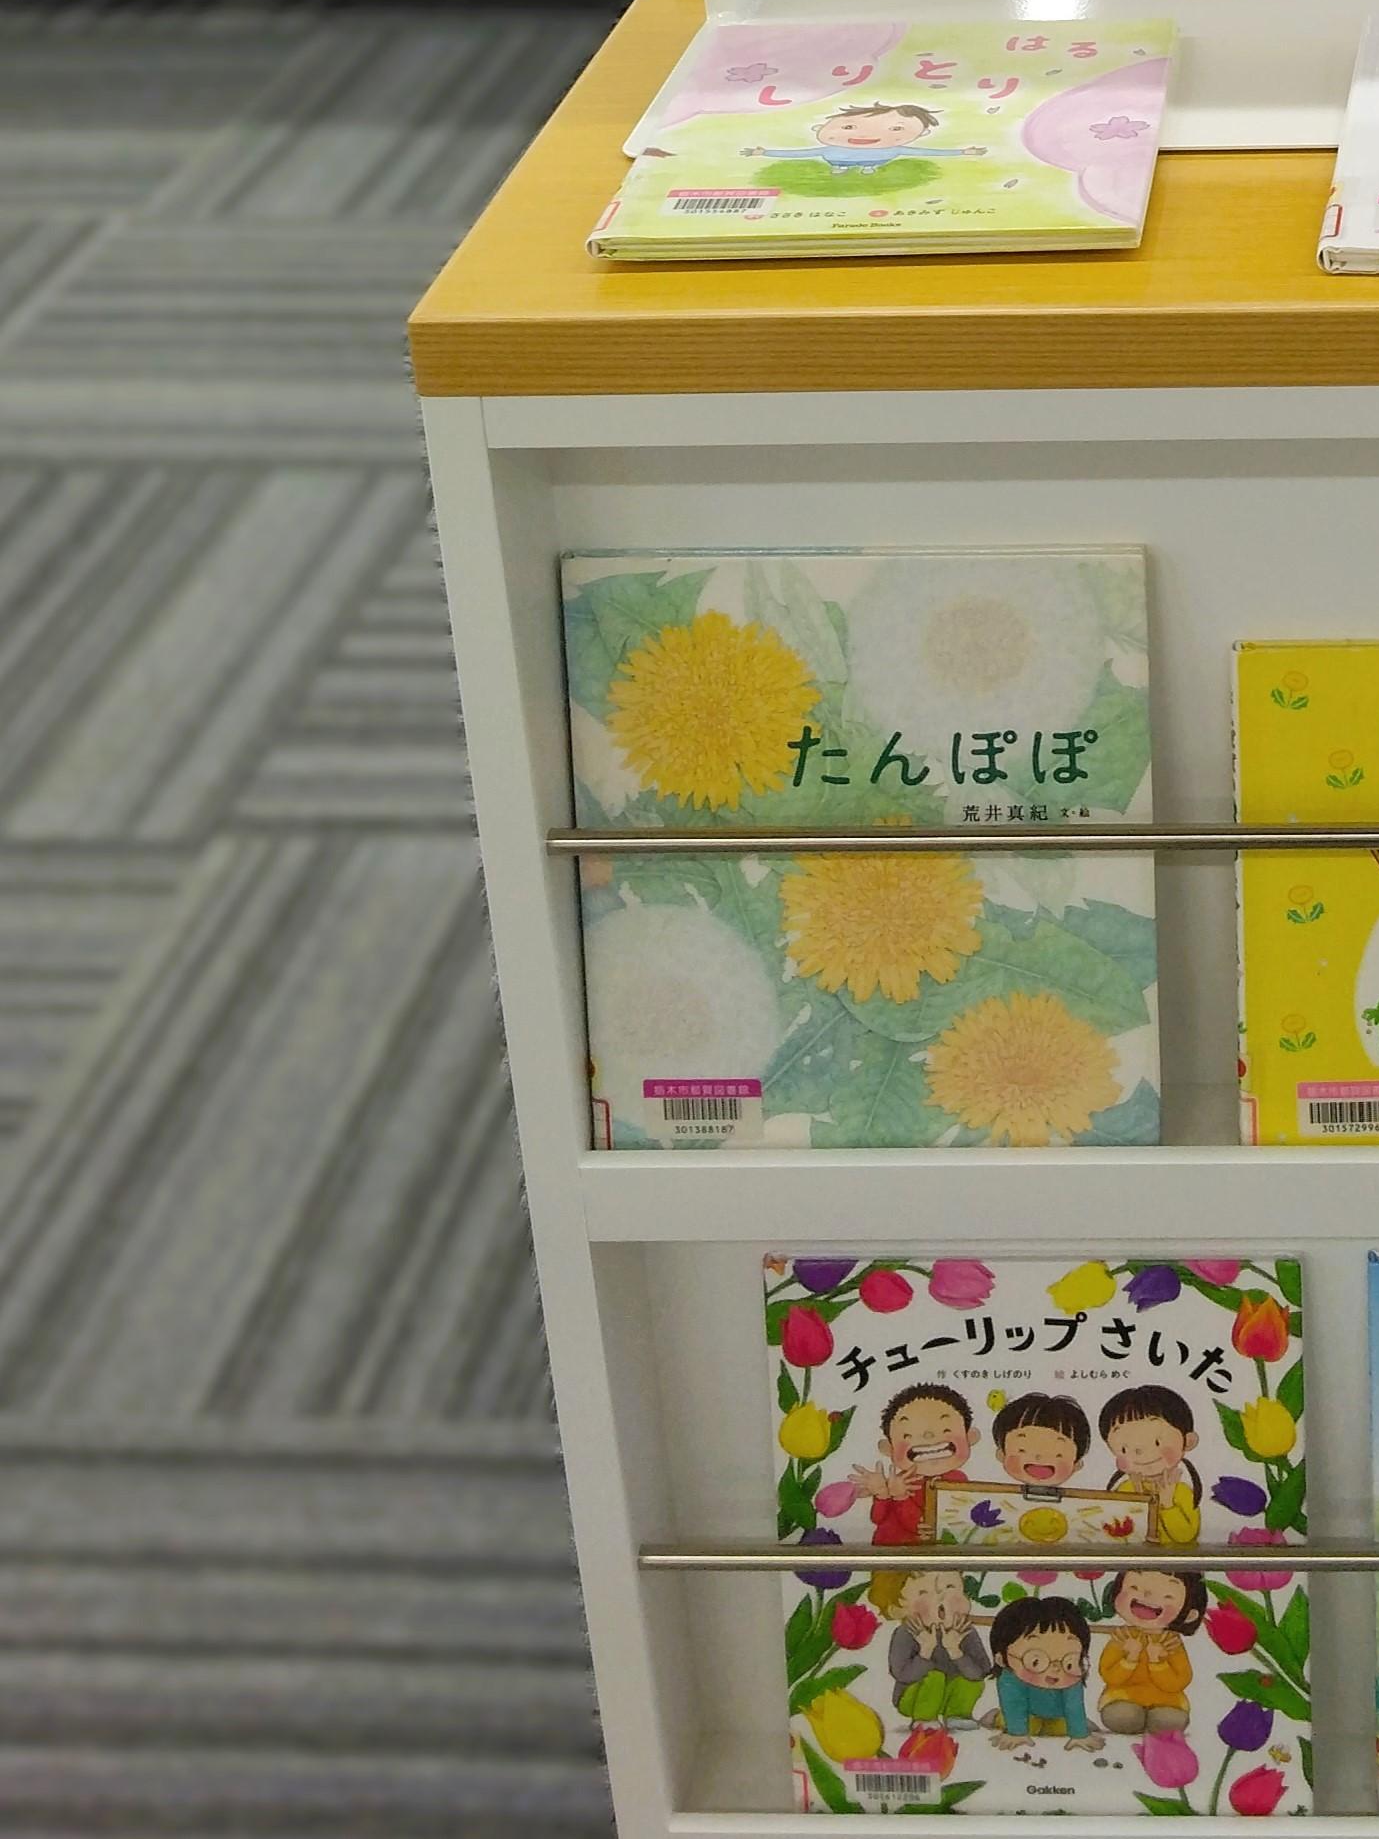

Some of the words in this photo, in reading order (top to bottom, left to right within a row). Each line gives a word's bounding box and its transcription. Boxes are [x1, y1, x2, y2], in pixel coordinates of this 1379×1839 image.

[1007, 34, 1099, 59] はる
[758, 60, 1021, 107] しりとり
[787, 725, 1099, 787] たんぽぽ
[963, 804, 1048, 822] 荒井真紀
[834, 1312, 1088, 1393] チューリップ
[1100, 1317, 1233, 1395] さいた
[953, 1370, 989, 1379] くすのき
[993, 1370, 1032, 1379] しげのり
[1070, 1370, 1108, 1379] よしむら
[1111, 1370, 1131, 1379] めぐ
[1026, 1784, 1076, 1795] Gakken
